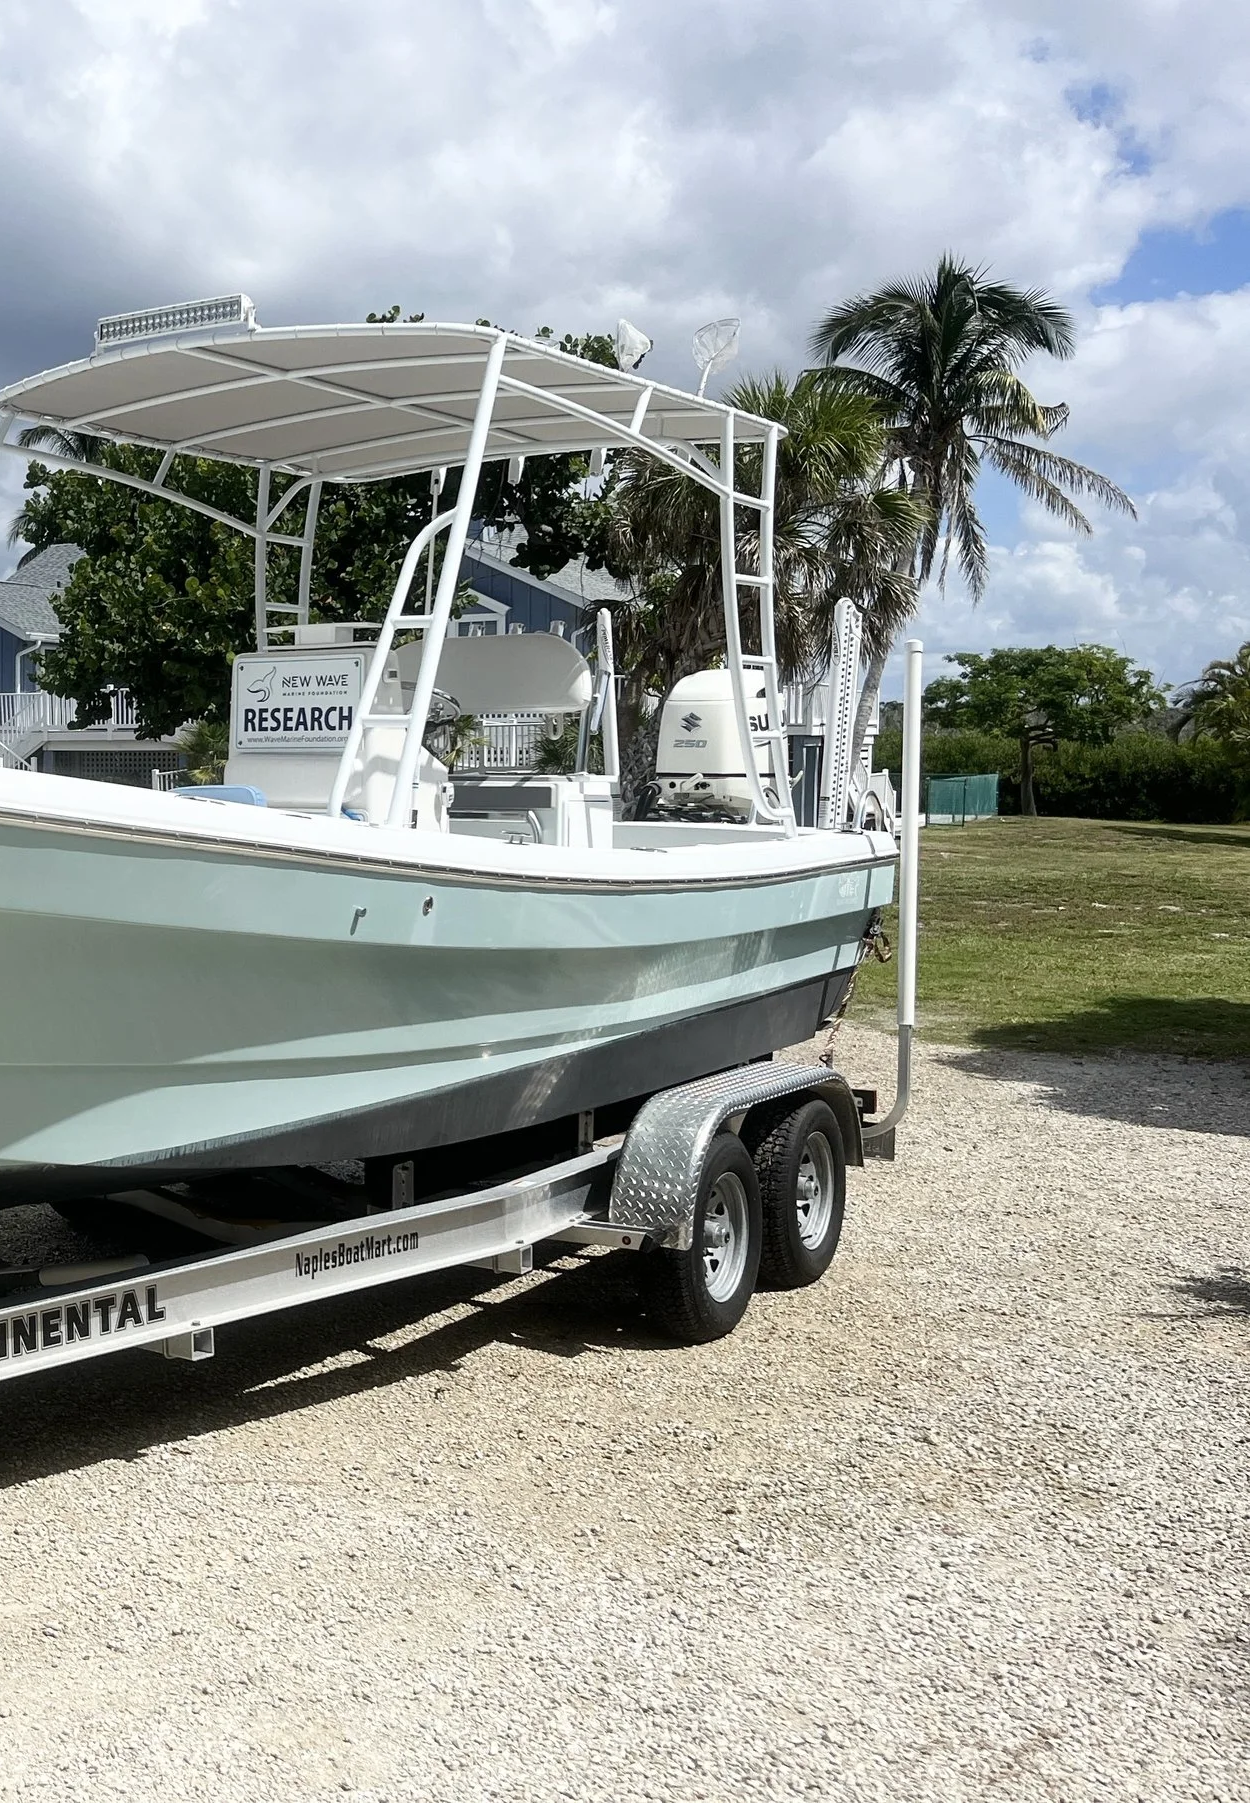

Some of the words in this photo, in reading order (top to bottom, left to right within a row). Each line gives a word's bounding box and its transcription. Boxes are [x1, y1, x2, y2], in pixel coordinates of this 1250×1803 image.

[282, 675, 311, 688] NEW
[316, 674, 349, 687] WAVE
[244, 706, 353, 732] RESEARCH
[673, 739, 708, 748] 250
[294, 1230, 420, 1281] NaplesBoatMart.com
